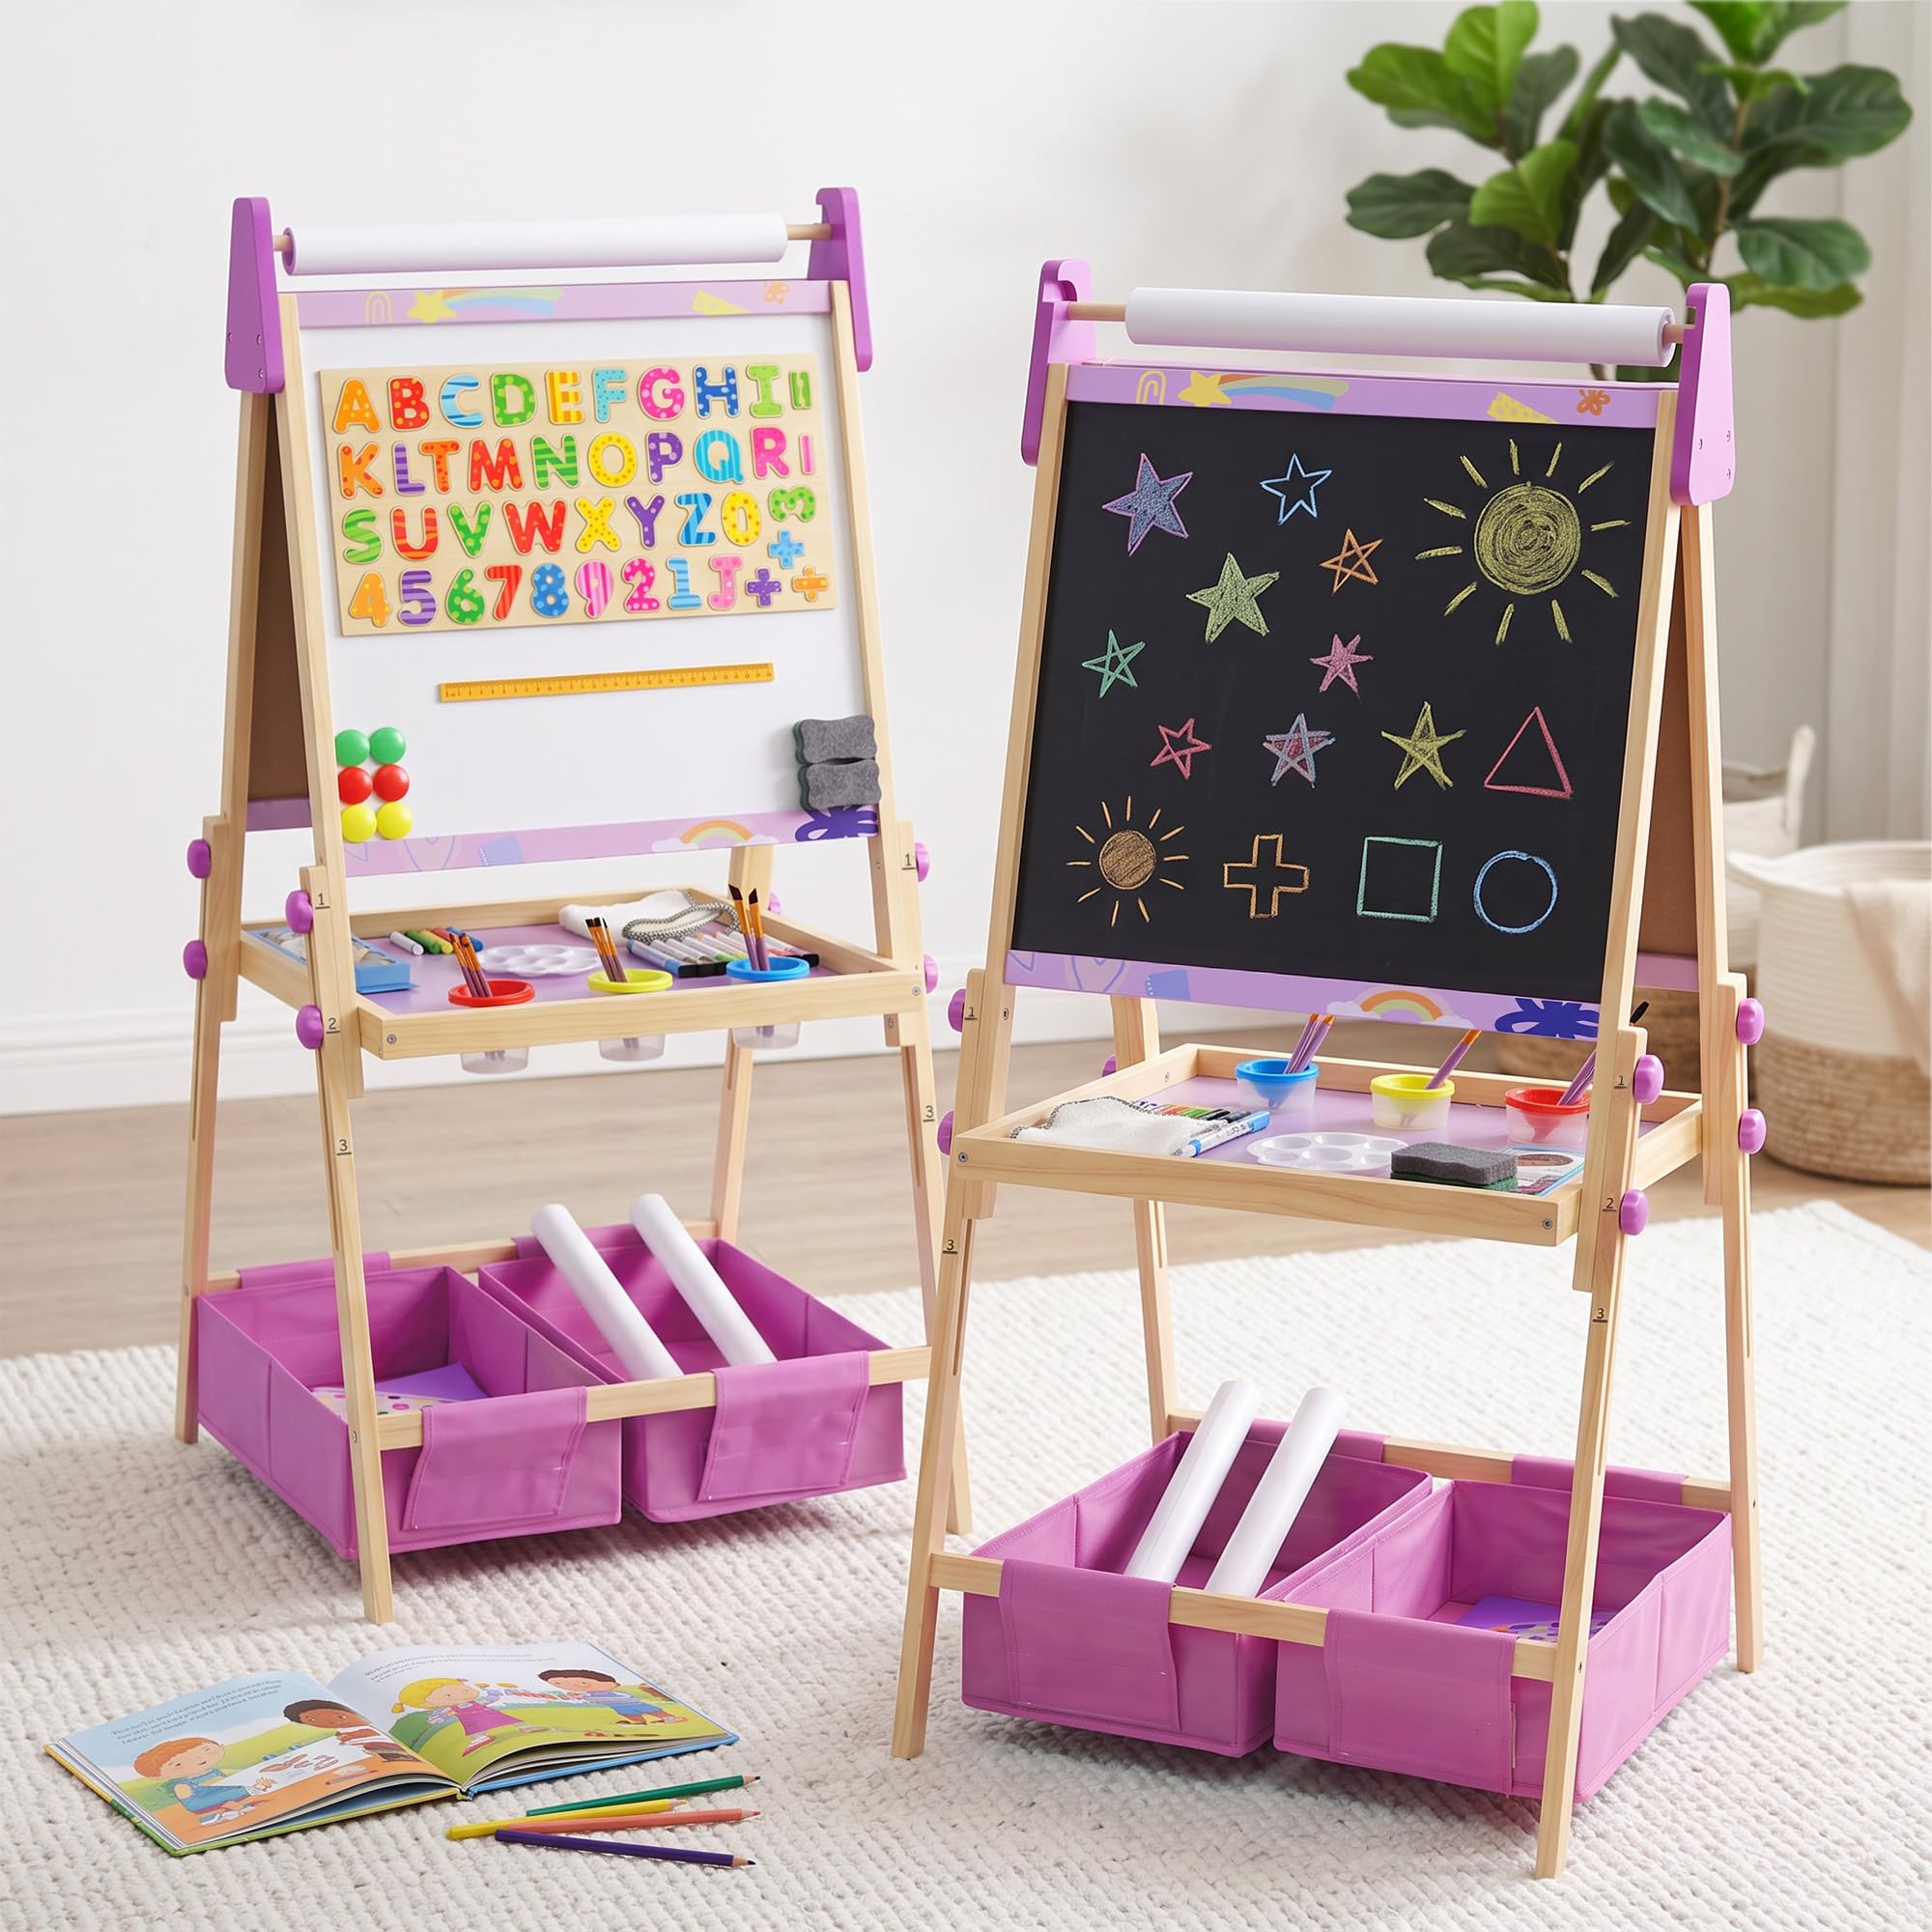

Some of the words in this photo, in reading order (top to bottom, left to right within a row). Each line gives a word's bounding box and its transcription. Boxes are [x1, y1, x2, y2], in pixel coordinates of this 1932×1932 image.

[334, 380, 381, 432] A
[388, 378, 430, 429] B
[440, 375, 484, 427] C
[492, 372, 536, 426] D
[547, 370, 584, 424] E
[594, 369, 626, 422] F
[639, 367, 684, 420] G
[696, 366, 740, 418] H
[339, 444, 384, 497] K
[393, 442, 424, 495] L
[420, 440, 460, 492] T
[469, 439, 524, 492] M
[532, 435, 580, 488] N
[647, 432, 683, 483] P
[695, 430, 744, 482] Q
[752, 428, 790, 478] R
[343, 509, 384, 563] S
[391, 506, 438, 559] U
[448, 502, 492, 557] V
[504, 499, 566, 554] W
[576, 497, 621, 552] X
[626, 495, 665, 548] Y
[676, 493, 716, 546] Z
[350, 572, 390, 627] 4
[399, 571, 437, 625] 5
[447, 568, 484, 623] 6
[485, 565, 522, 619] 7
[532, 563, 569, 618] 8
[623, 558, 661, 611] 2
[709, 555, 742, 610] J
[904, 853, 912, 867] 1
[317, 893, 326, 906] 1
[968, 1007, 975, 1017] 1
[327, 1017, 337, 1030] 2
[1617, 1075, 1625, 1087] 1
[926, 1105, 934, 1118] 3
[338, 1139, 348, 1151] 3
[1605, 1198, 1614, 1209] 2
[946, 1239, 954, 1251] 3
[1596, 1308, 1605, 1320] 3
